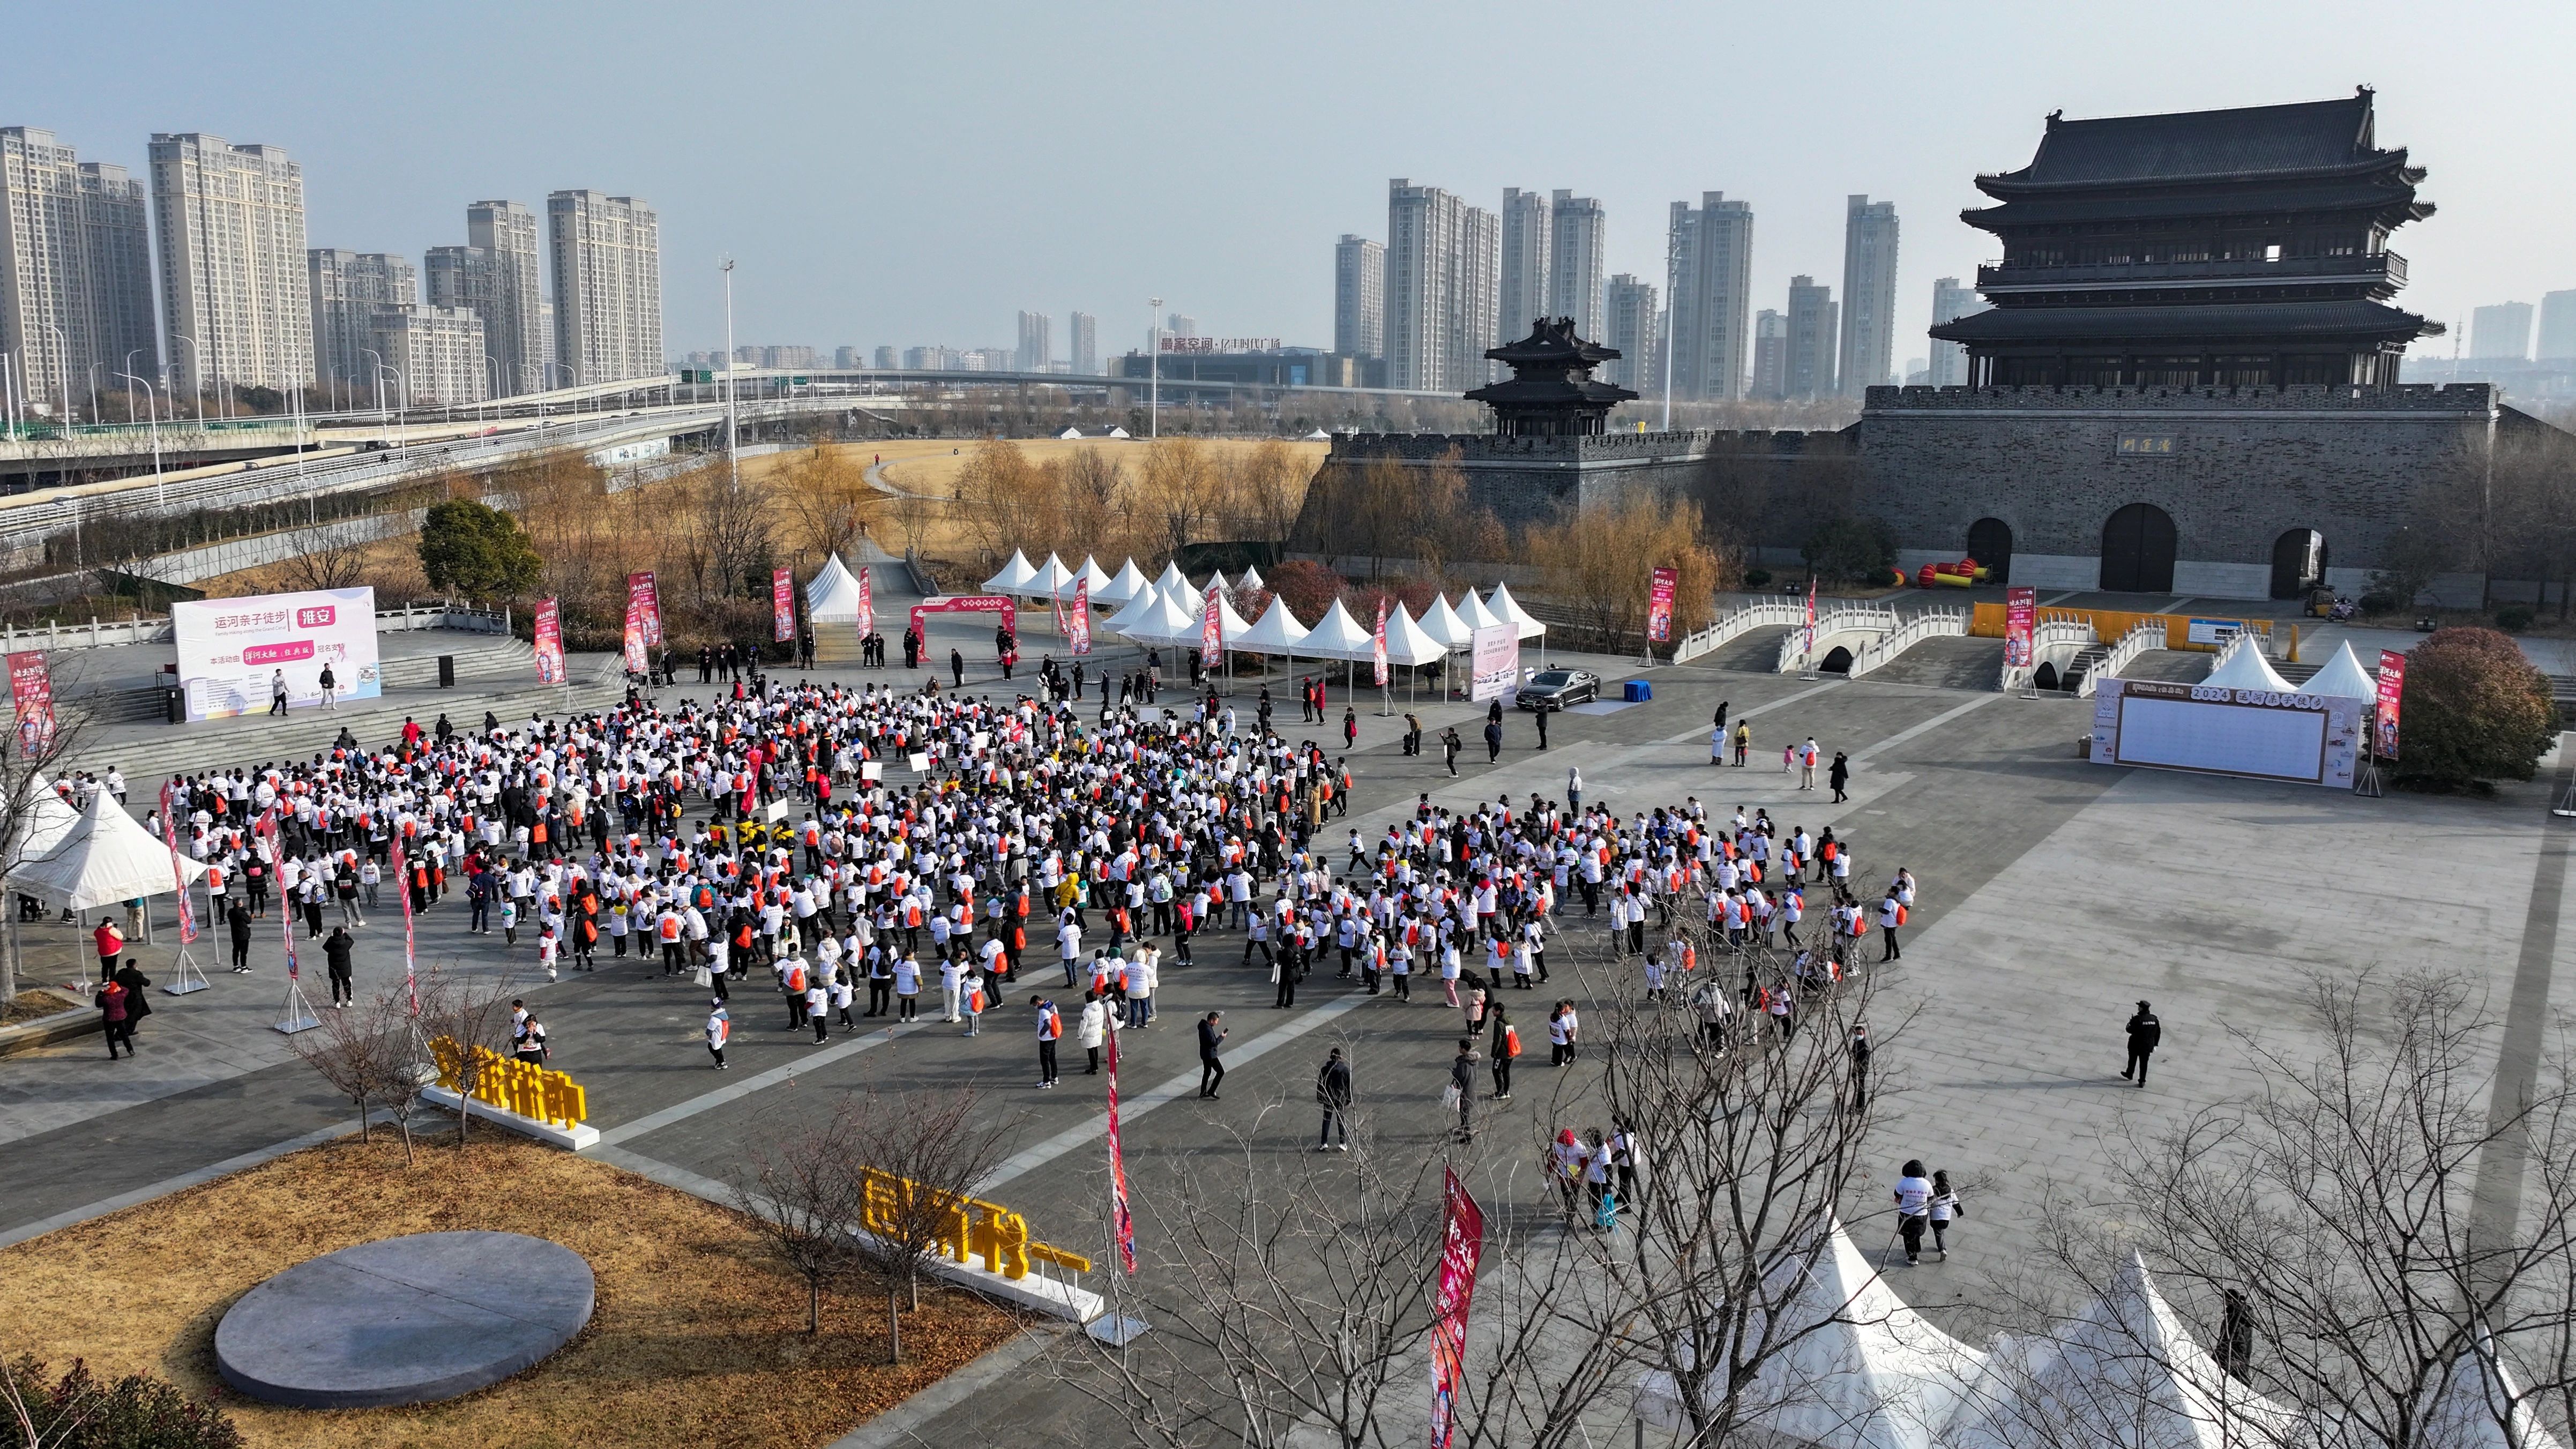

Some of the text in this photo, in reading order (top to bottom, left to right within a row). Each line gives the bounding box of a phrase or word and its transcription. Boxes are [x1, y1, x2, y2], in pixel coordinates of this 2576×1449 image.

[214, 609, 330, 629] 运河亲子徒步 淮安
[210, 655, 240, 664] 本活动由
[317, 643, 345, 653] 冠名支持
[2194, 689, 2227, 699] 2024
[2239, 690, 2322, 706] 运河亲子徒步
